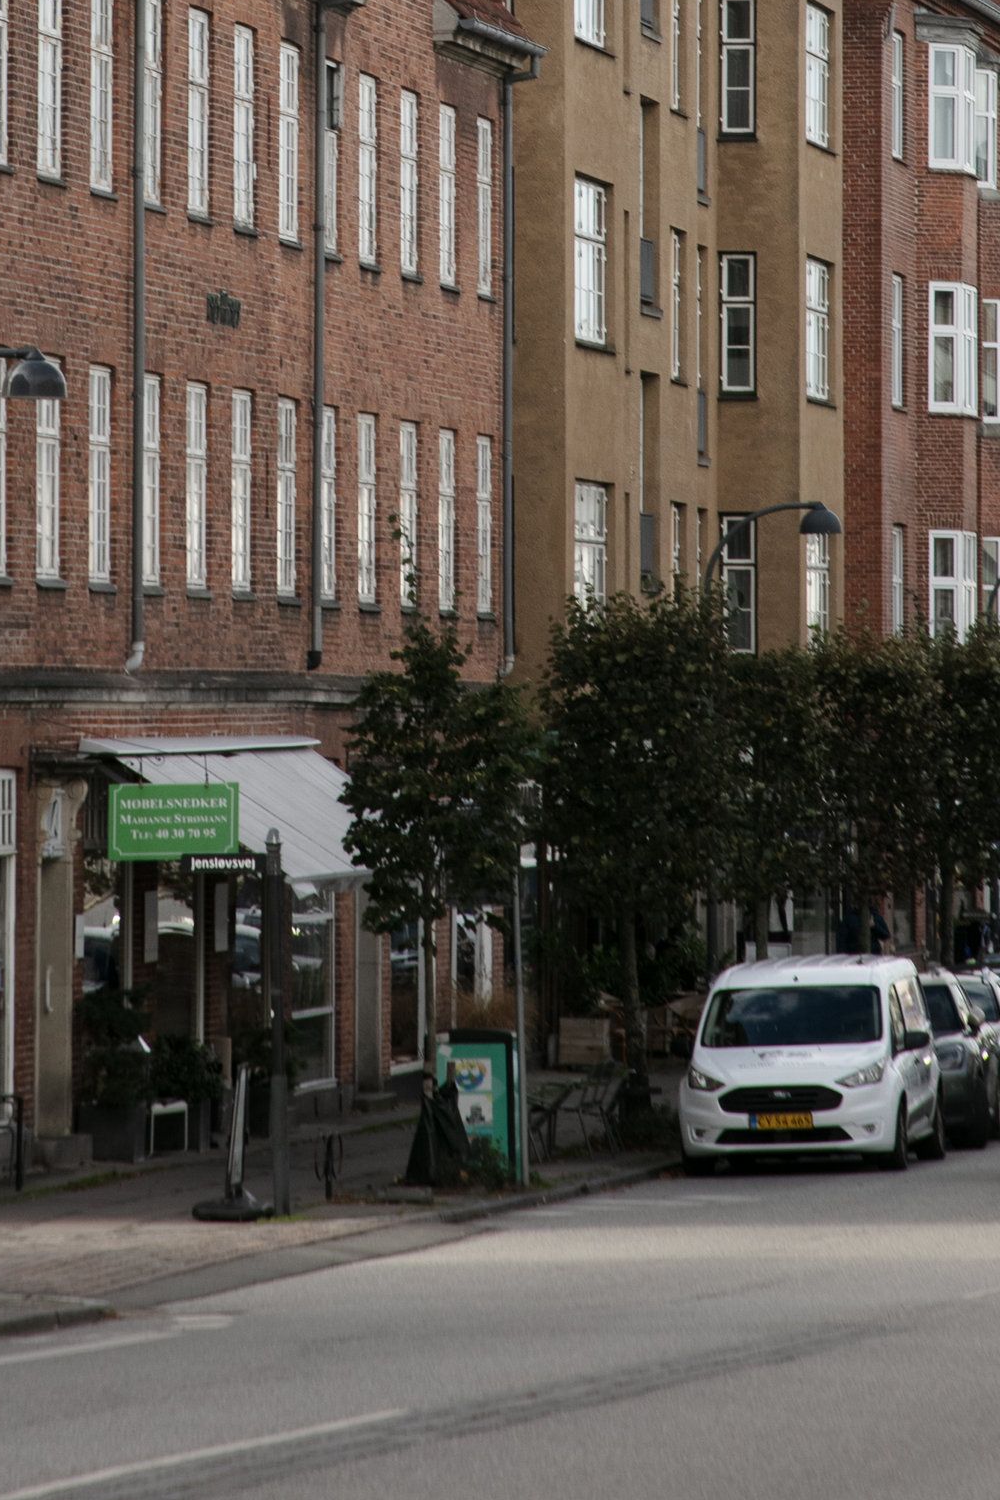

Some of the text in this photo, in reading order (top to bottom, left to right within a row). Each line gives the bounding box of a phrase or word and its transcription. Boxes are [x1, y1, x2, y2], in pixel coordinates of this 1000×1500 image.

[155, 829, 168, 838] 40
[171, 828, 184, 838] 30
[188, 828, 200, 837] 70
[203, 828, 216, 837] 95
